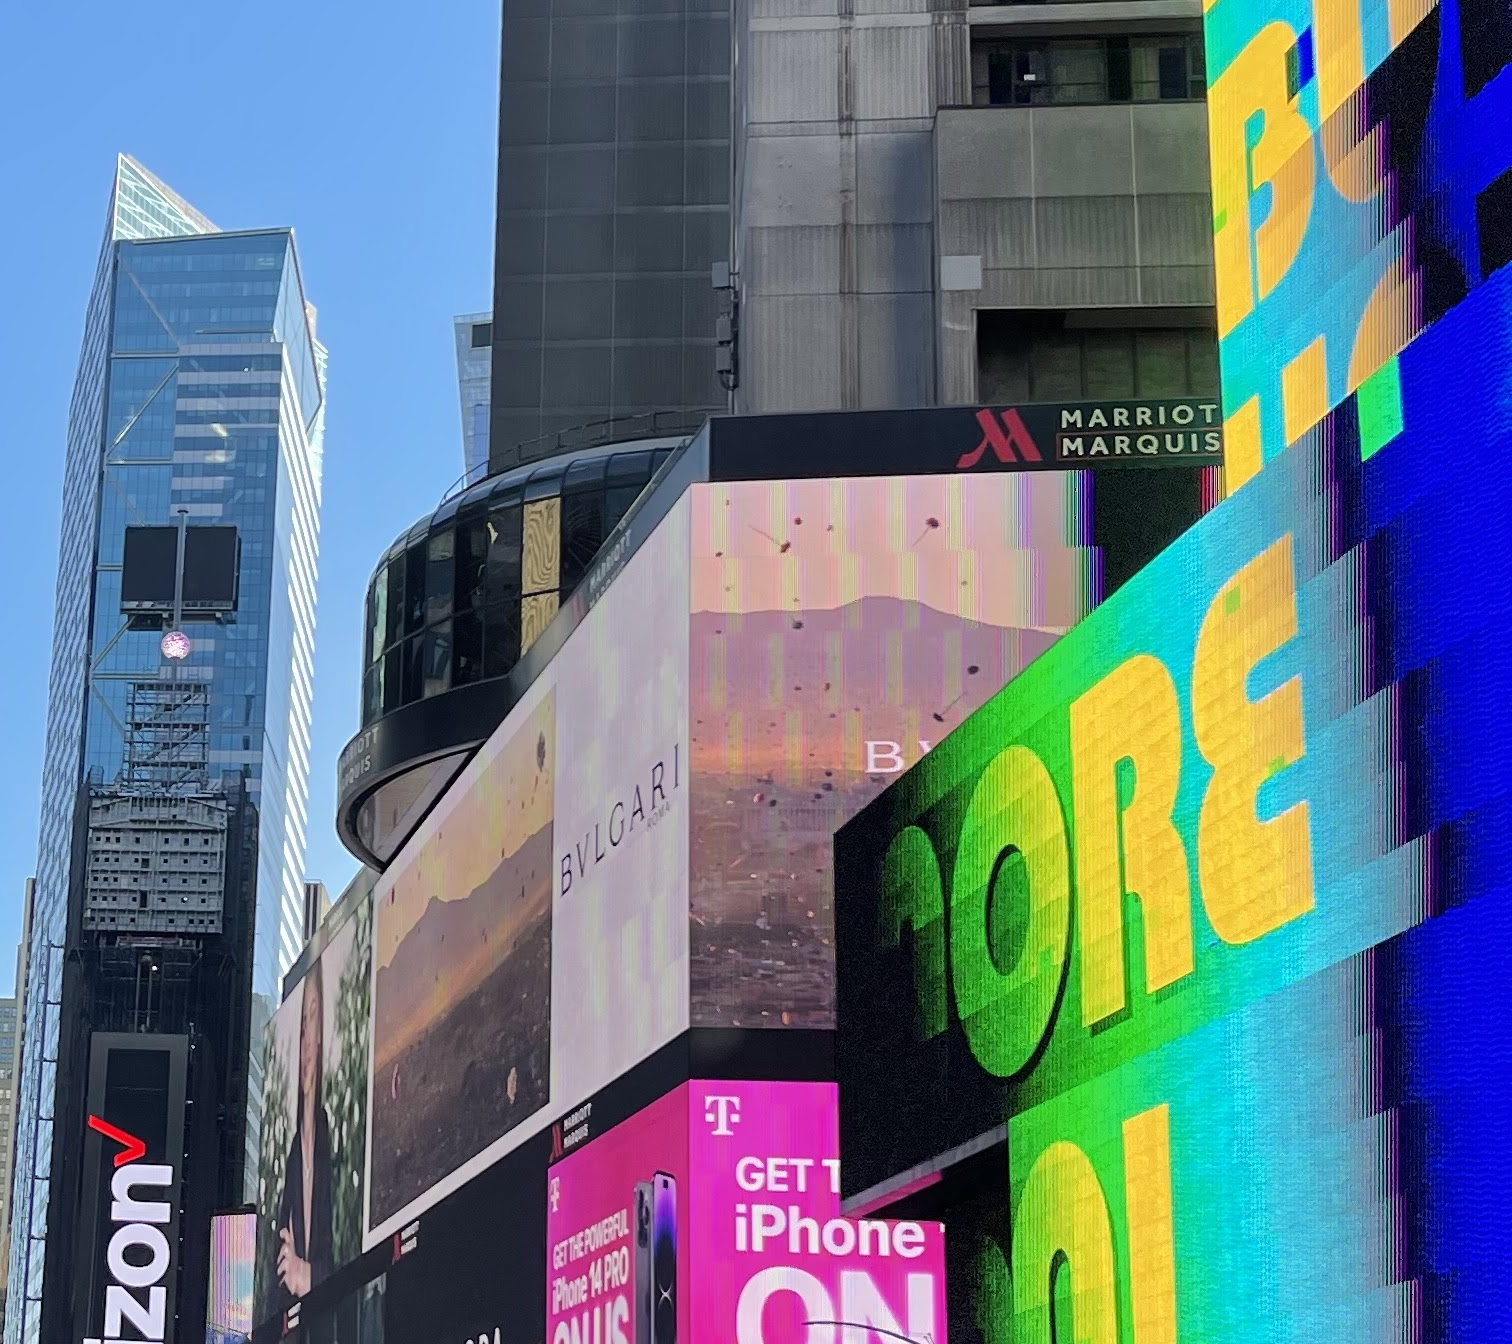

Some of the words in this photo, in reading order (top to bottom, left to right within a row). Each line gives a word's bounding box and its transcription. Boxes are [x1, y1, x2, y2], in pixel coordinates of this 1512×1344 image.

[1060, 403, 1218, 429] MARRIOT
[1061, 432, 1221, 456] MARQUIS
[560, 742, 679, 897] BVLGARI
[735, 1156, 813, 1193] GET
[553, 1237, 569, 1271] GET
[568, 1230, 585, 1262] THE
[584, 1208, 630, 1254] POWERFUL
[735, 1204, 926, 1259] iPhone
[552, 1273, 588, 1316] iPhone
[589, 1259, 603, 1297] 14
[603, 1245, 630, 1292] PRO
